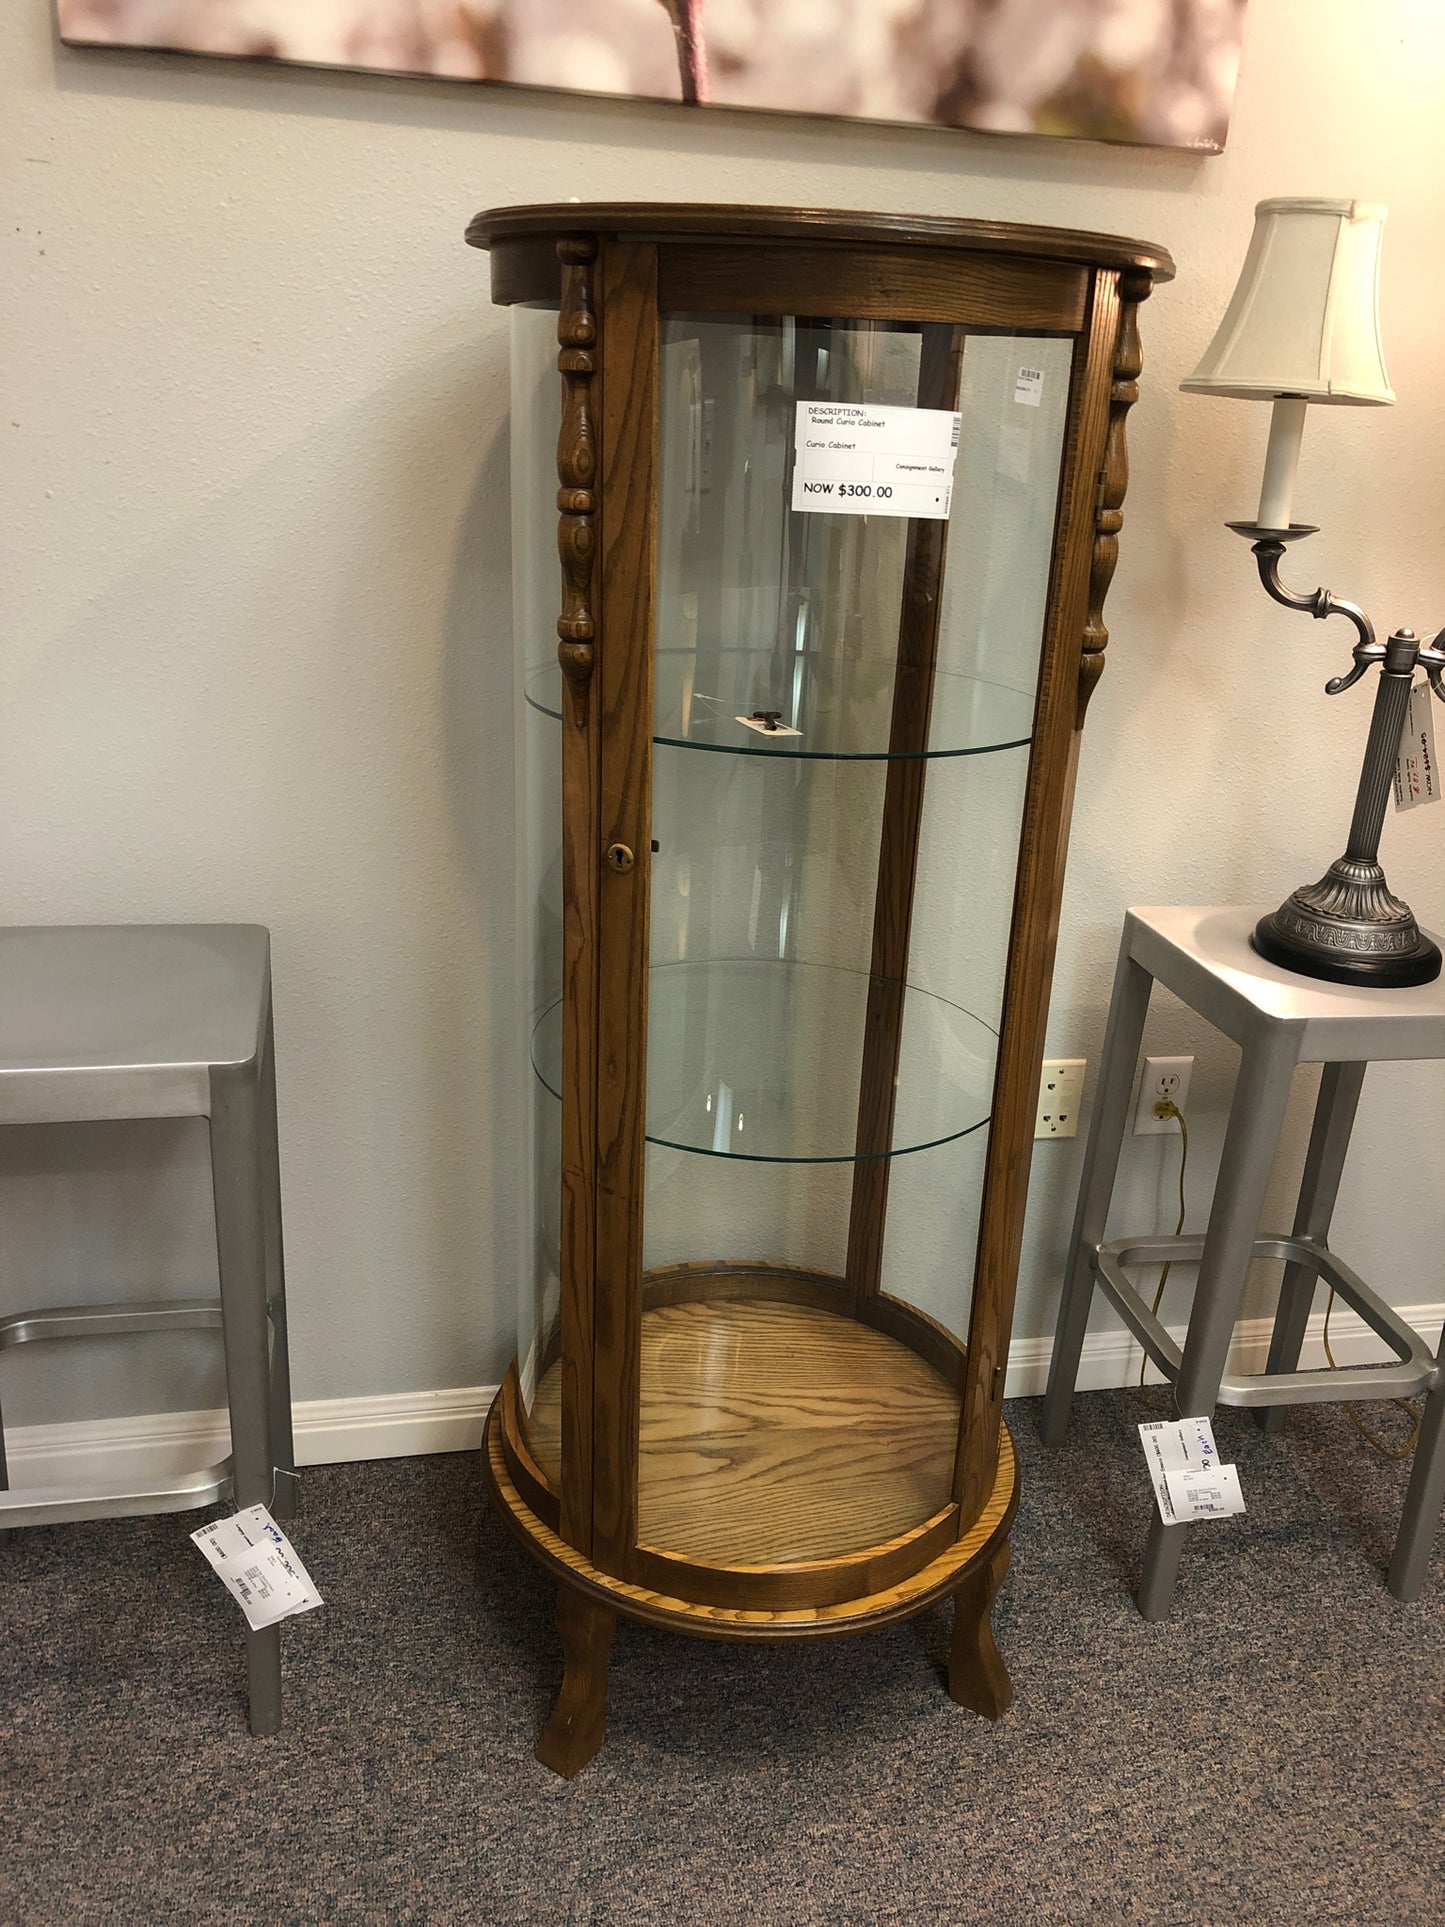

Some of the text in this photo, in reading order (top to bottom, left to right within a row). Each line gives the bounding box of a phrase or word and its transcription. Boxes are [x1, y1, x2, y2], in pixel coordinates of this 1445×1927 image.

[809, 407, 866, 417] DESCRIPTION:
[812, 417, 885, 427] Round Curio Cabinet
[806, 440, 856, 449] Curio Cabinet
[804, 483, 892, 498] NOW $300.00
